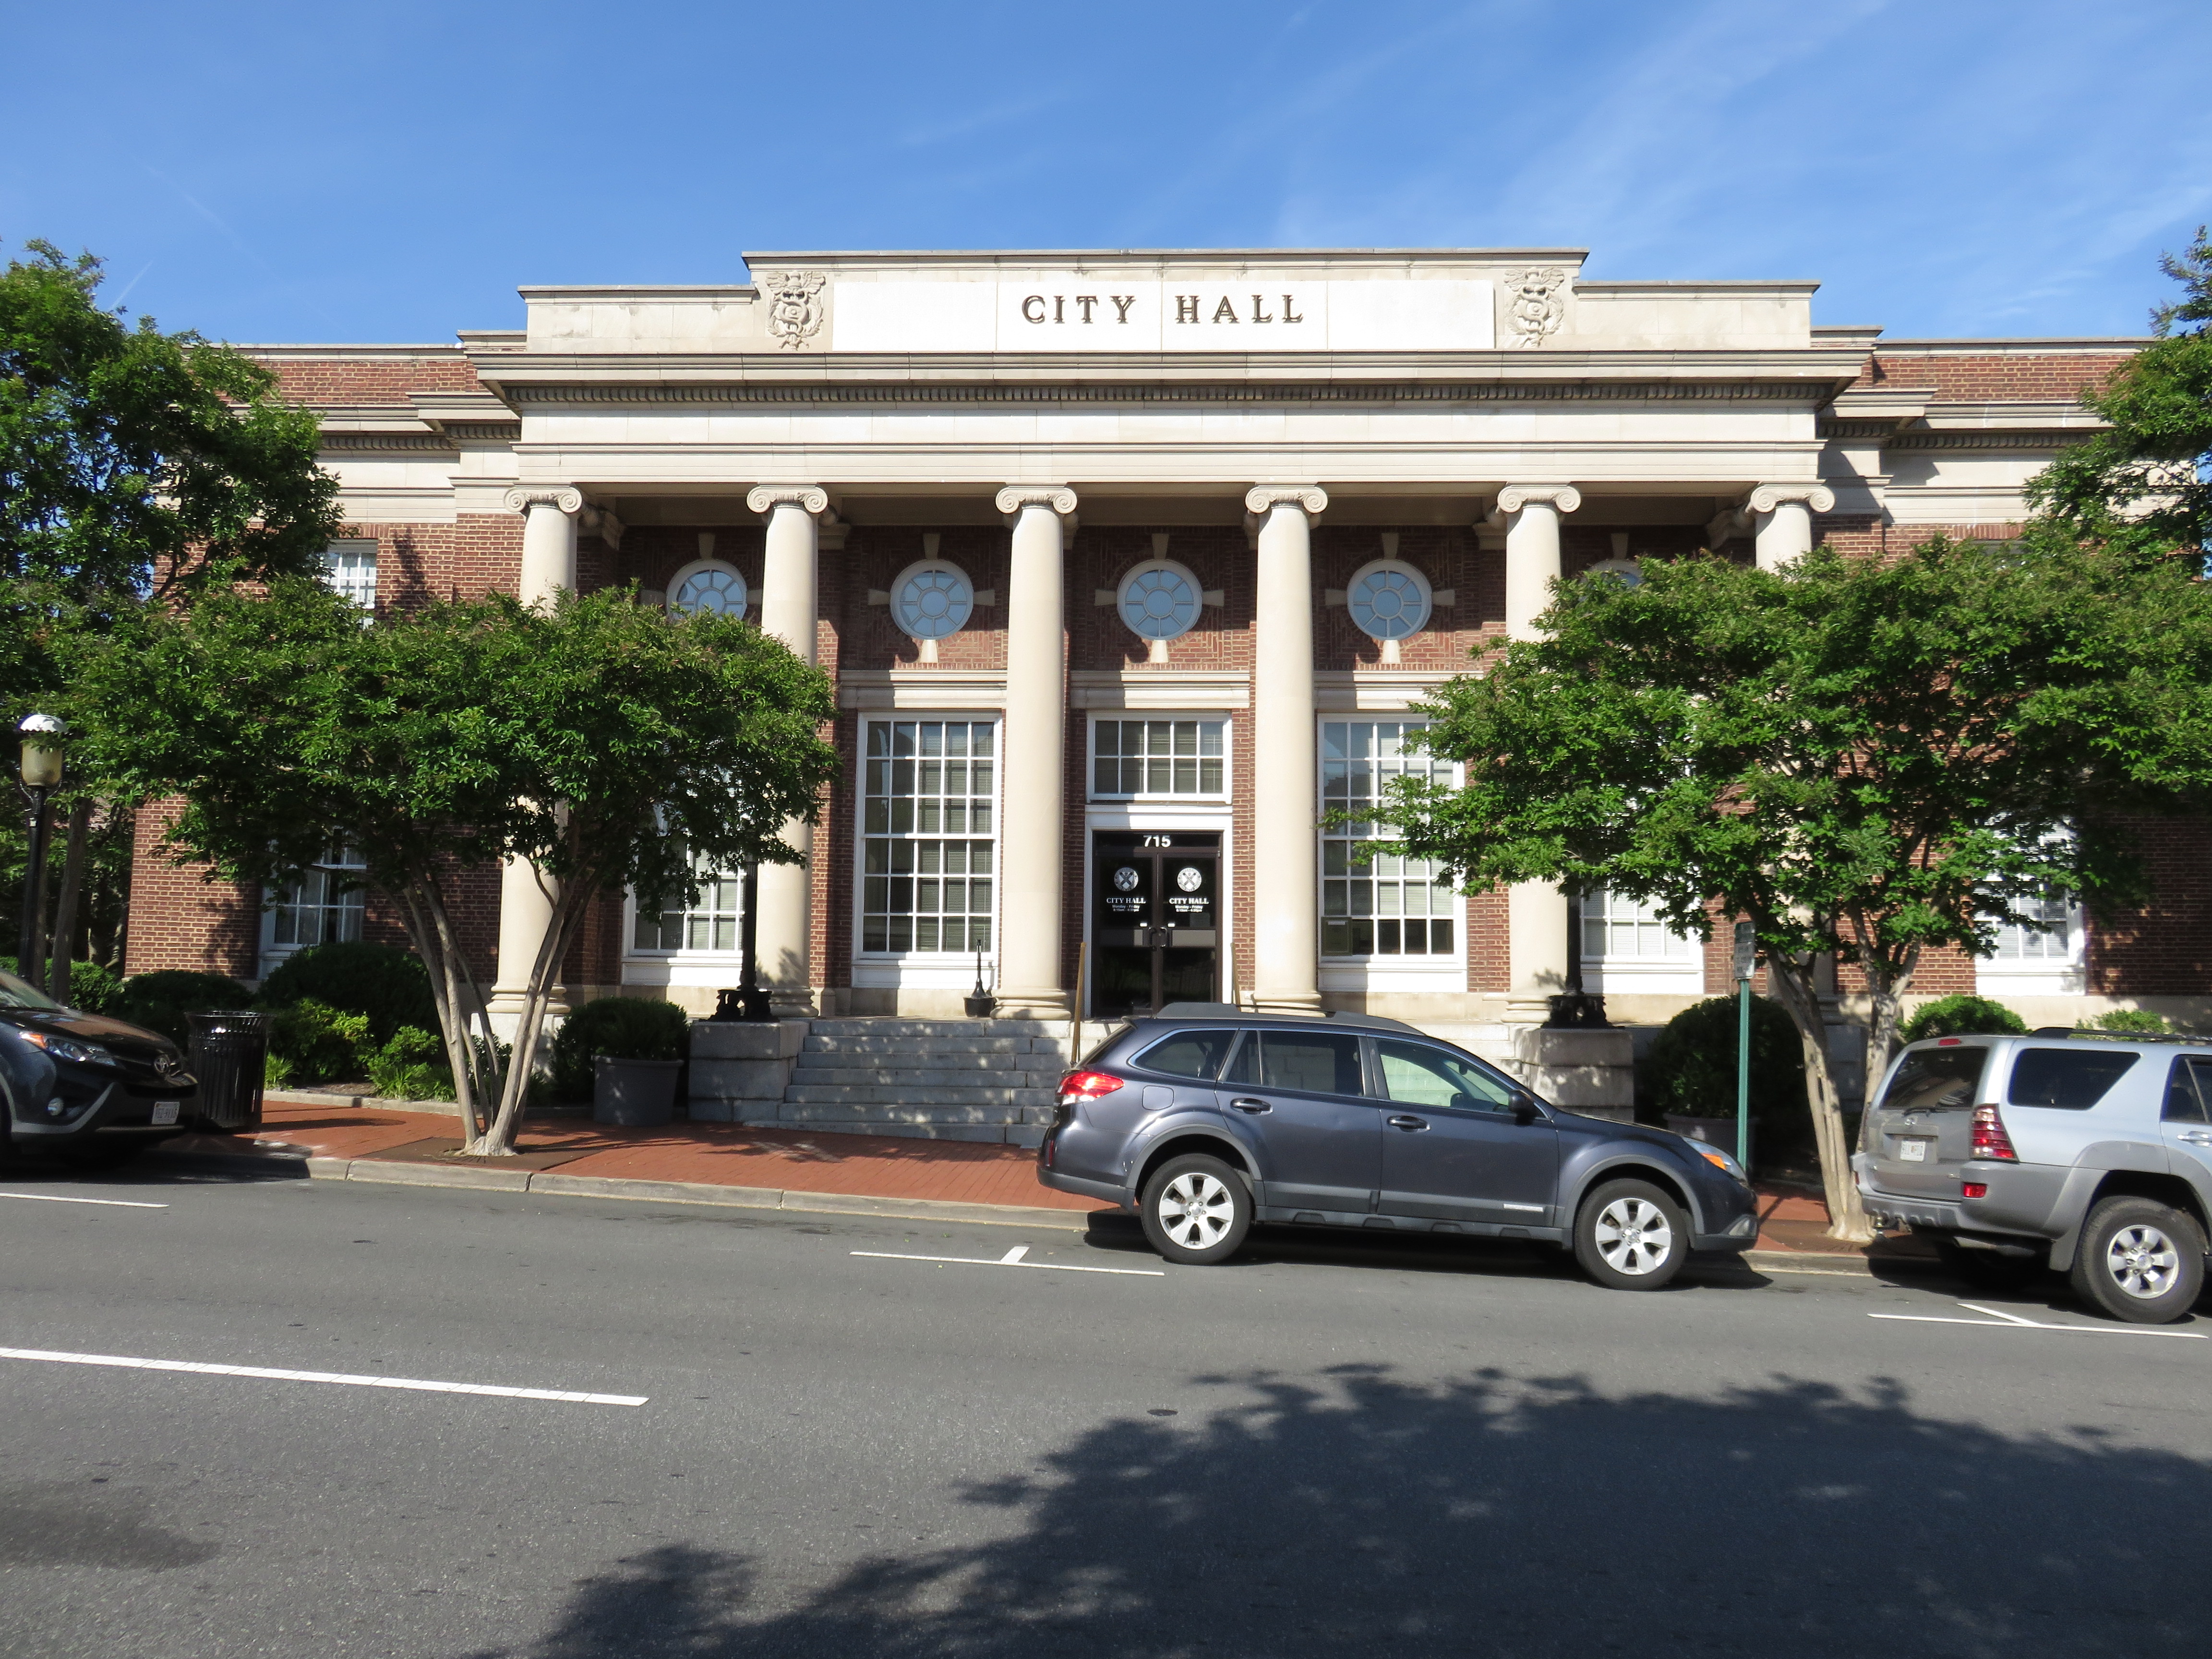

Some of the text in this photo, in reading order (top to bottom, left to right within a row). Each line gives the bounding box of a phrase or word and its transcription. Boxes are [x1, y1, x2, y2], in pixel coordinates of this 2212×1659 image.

[1022, 294, 1303, 325] CITY HALL
[1143, 835, 1171, 848] 715
